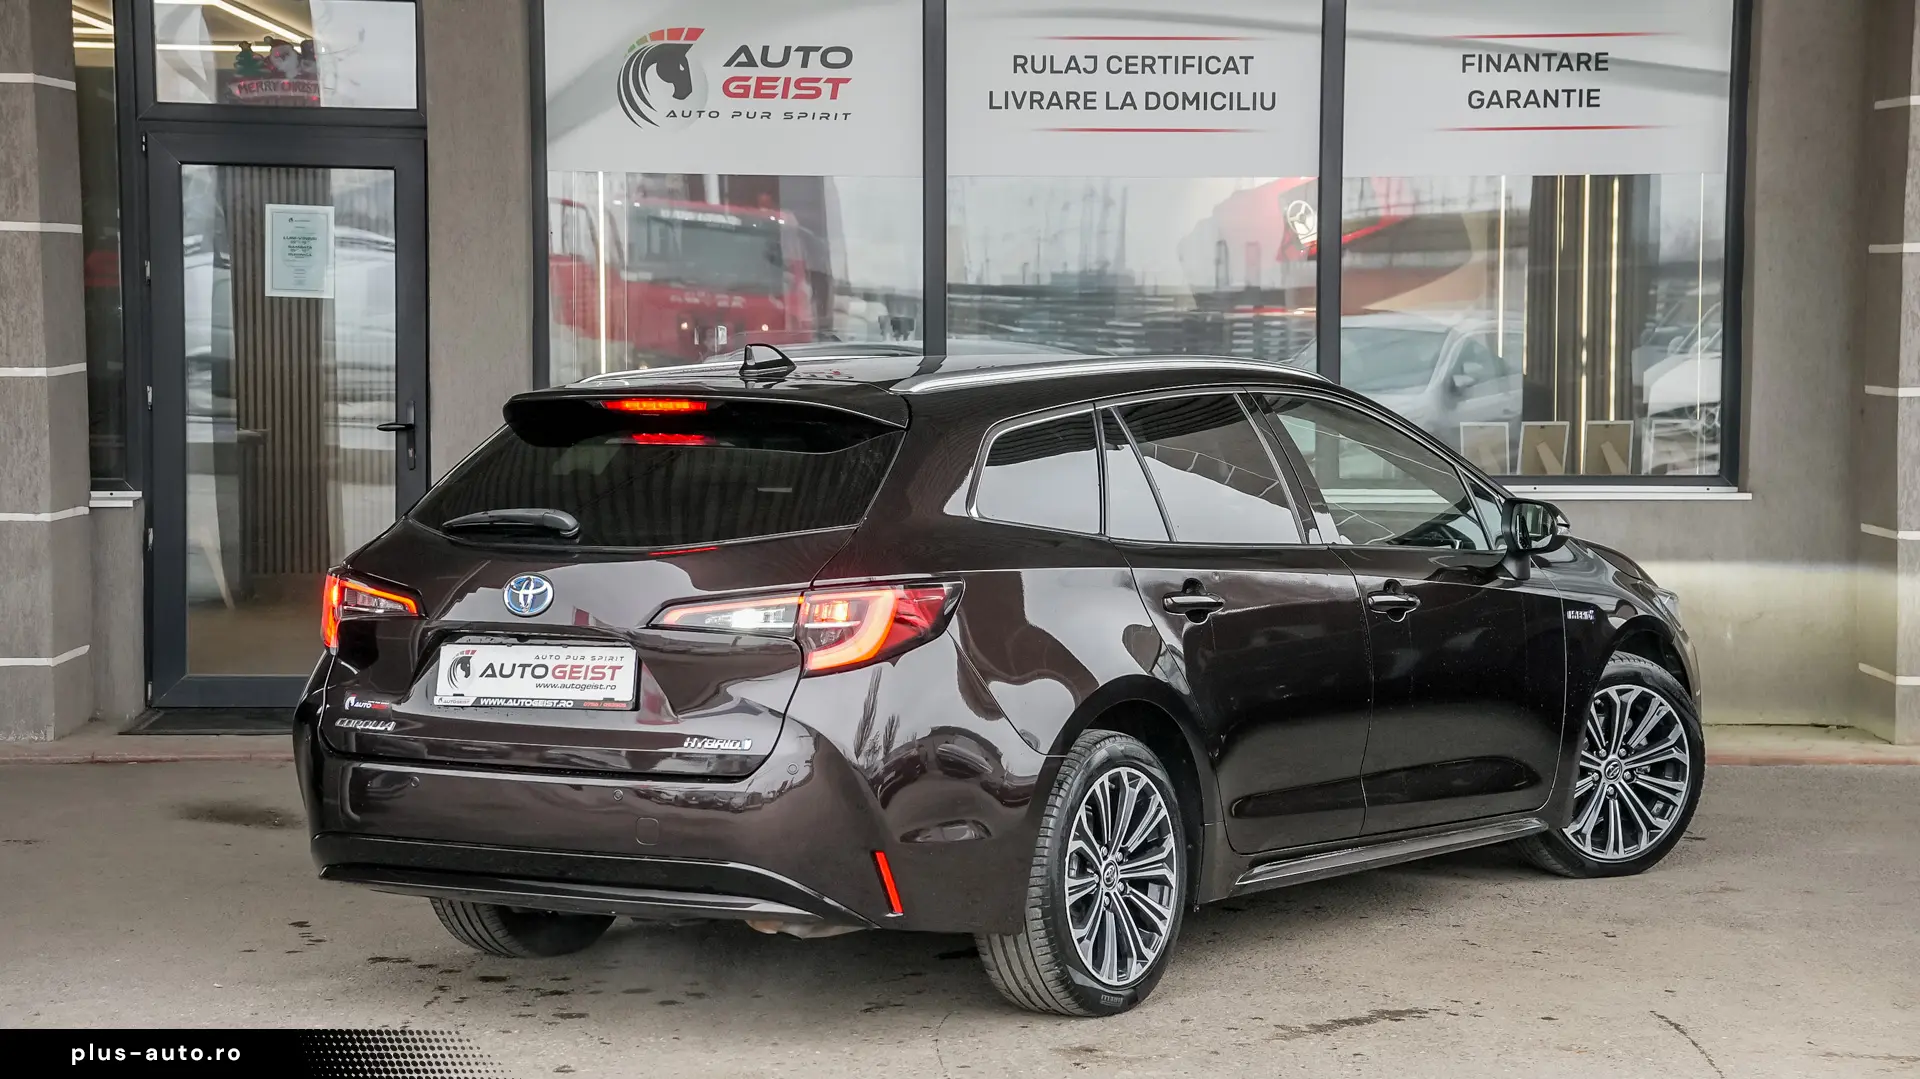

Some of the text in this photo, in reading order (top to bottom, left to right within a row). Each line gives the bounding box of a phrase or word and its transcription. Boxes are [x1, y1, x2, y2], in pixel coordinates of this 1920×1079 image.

[722, 44, 853, 69] AUTO
[1012, 54, 1254, 75] RULAJ CERTIFICAT
[1462, 52, 1609, 73] FINANTARE
[722, 75, 852, 100] GEIST
[988, 90, 1276, 111] LIVRARE LA DOMICILIU
[1467, 88, 1601, 109] GARANTIE
[665, 109, 852, 121] AUTO PUR SPIRIT
[535, 683, 617, 691] www.autogeist.ro
[480, 697, 574, 708] WWW.AUTOGEIST.RO
[335, 718, 396, 731] COROLLA
